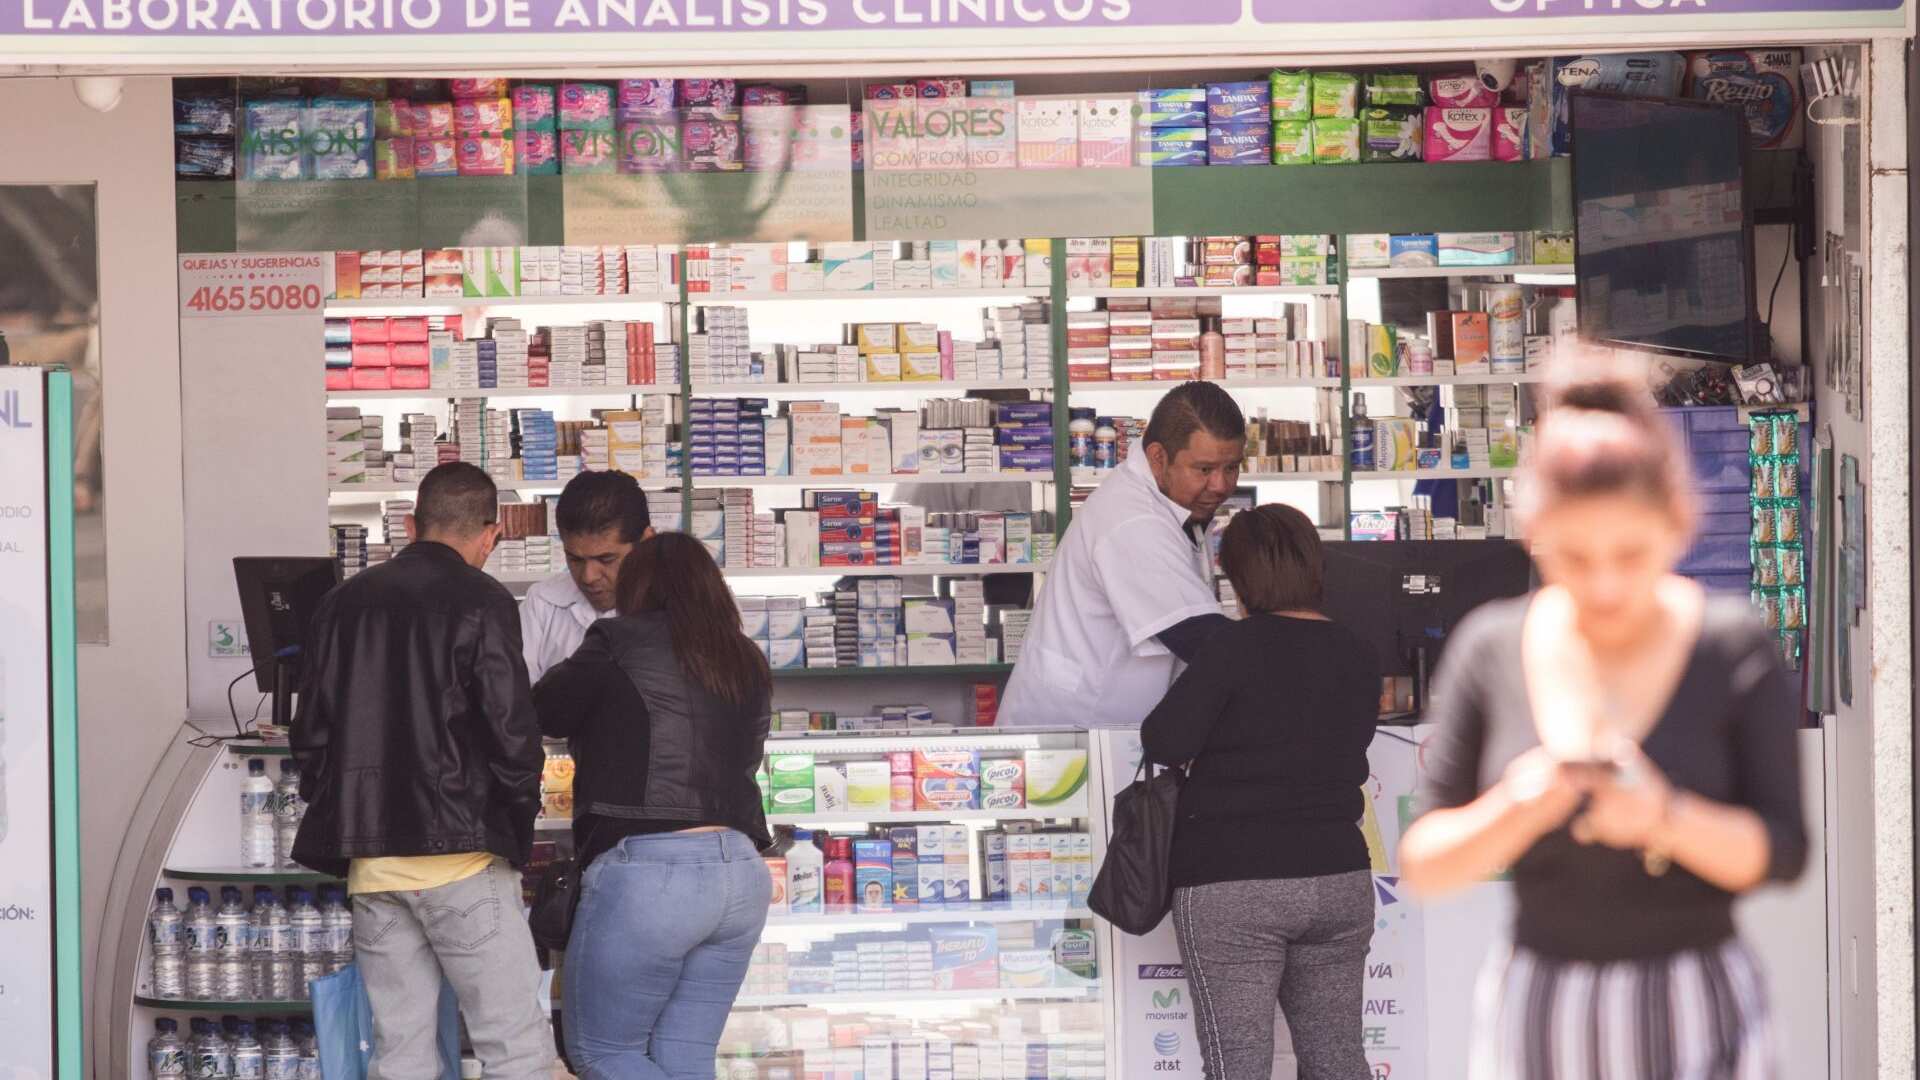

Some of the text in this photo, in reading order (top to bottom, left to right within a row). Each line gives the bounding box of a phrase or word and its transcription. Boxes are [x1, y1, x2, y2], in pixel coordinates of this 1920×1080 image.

[23, 0, 442, 30] LABORATORIO
[466, 0, 531, 28] DE
[1562, 67, 1599, 76] TENA
[1221, 94, 1258, 103] TAMPAX
[1448, 111, 1479, 121] kotex
[870, 108, 1006, 139] VALORES
[1223, 135, 1260, 144] TAMPAX
[872, 150, 1000, 167] COMPROMISO
[872, 171, 977, 188] INTEGRIDAD
[873, 194, 977, 210] DINAMISMO
[874, 215, 946, 232] LEALTAD
[183, 257, 321, 270] QUEJAS Y SUGERENCIAS
[187, 284, 321, 311] 4165 5080
[1154, 966, 1185, 978] telce
[1145, 1011, 1188, 1020] movistar
[1153, 1060, 1182, 1071] at&t
